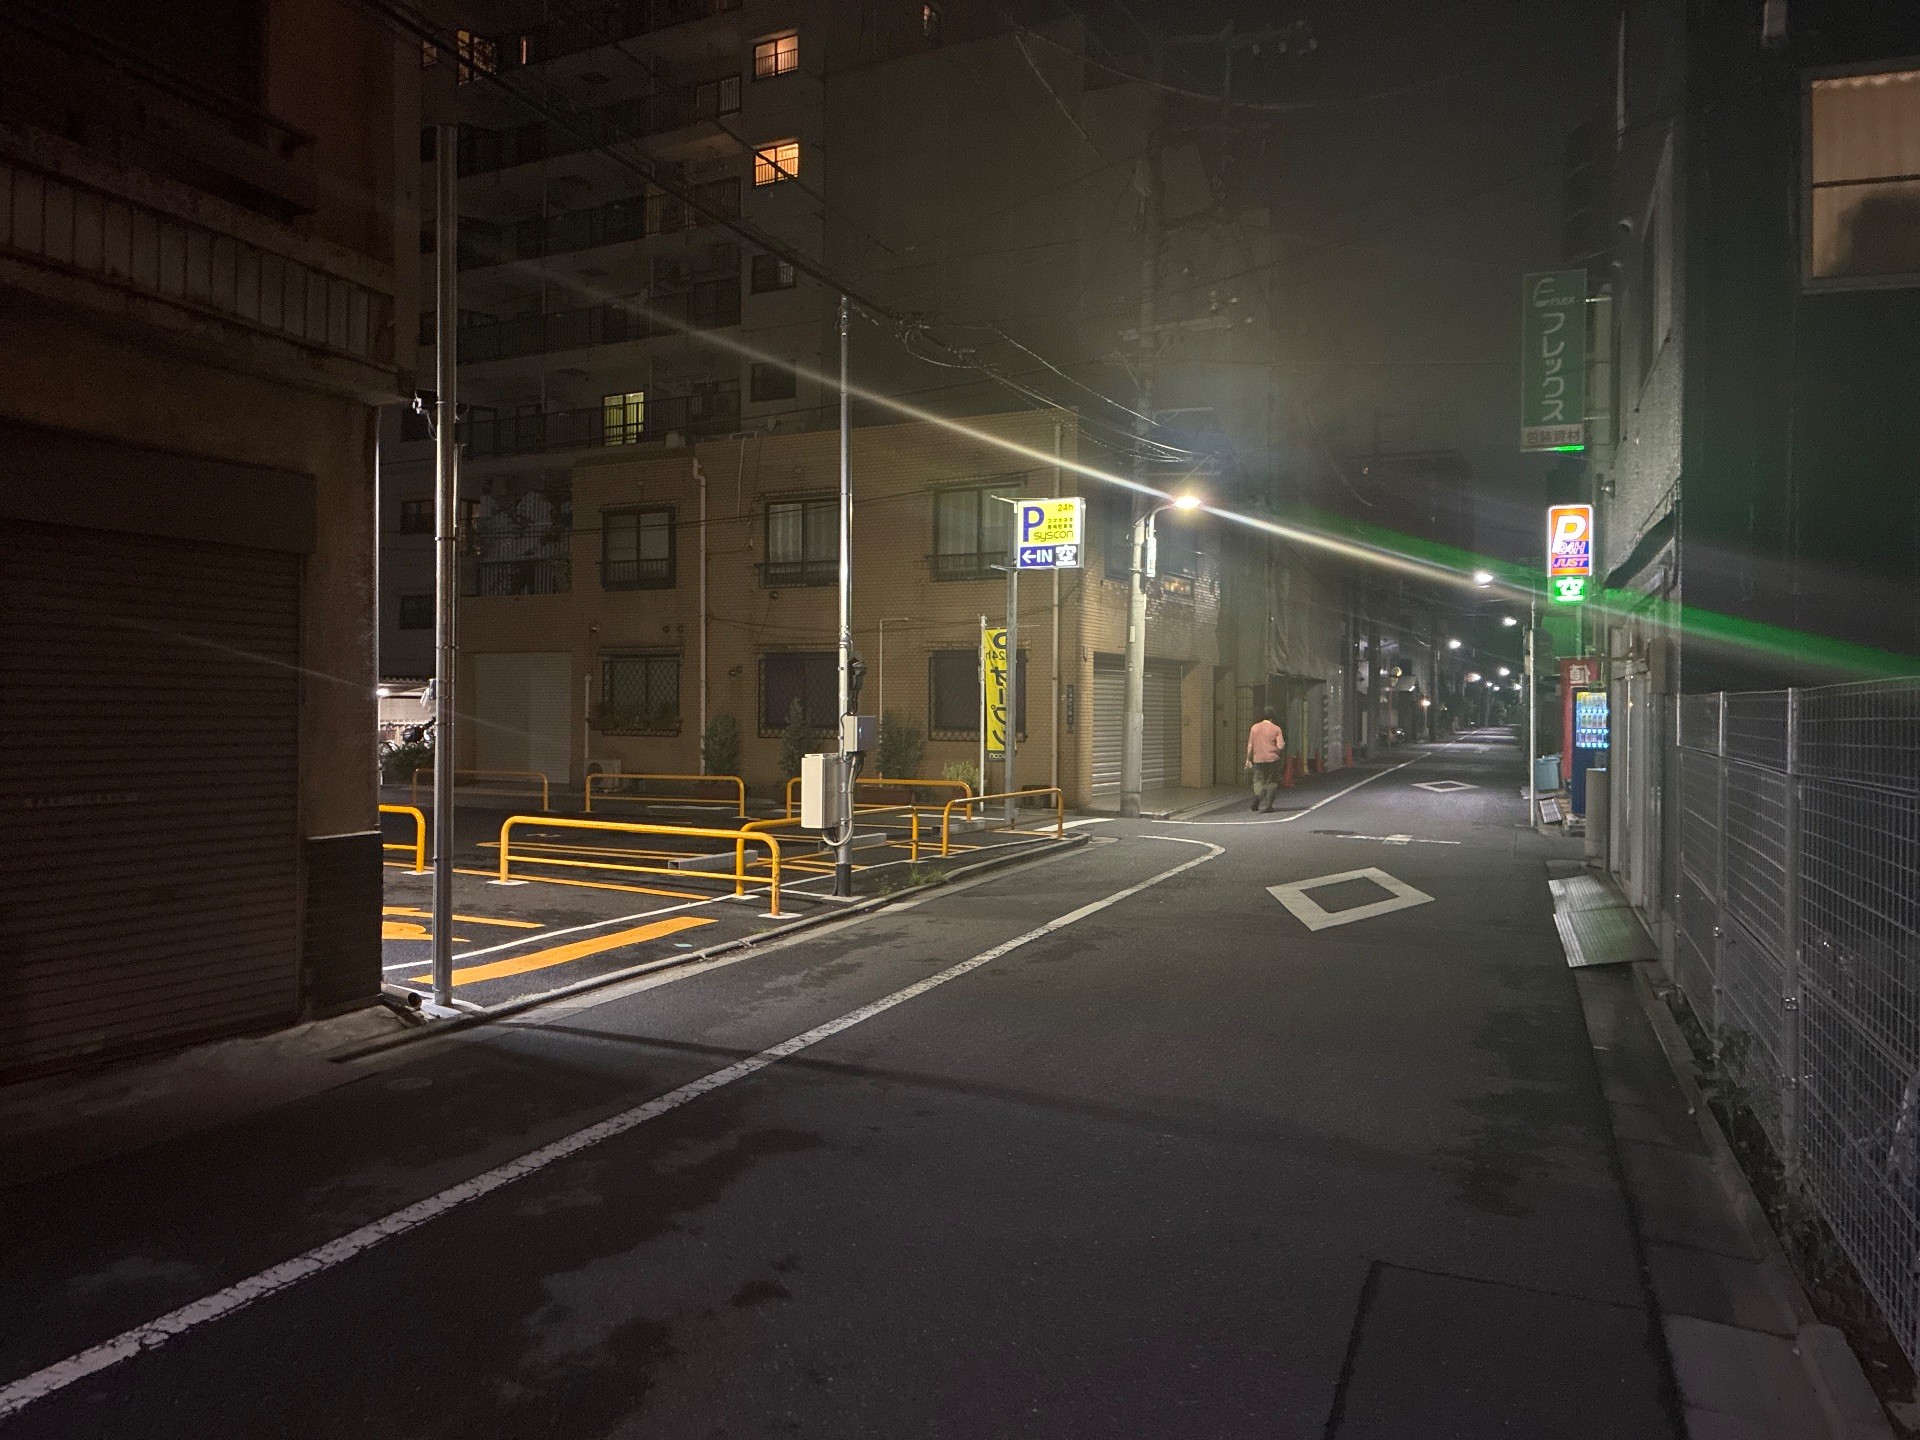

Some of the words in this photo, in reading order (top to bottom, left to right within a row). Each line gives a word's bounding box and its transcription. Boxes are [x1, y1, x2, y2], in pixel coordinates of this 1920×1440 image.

[1540, 311, 1566, 423] フレックス
[1057, 504, 1074, 512] 24h
[1023, 506, 1045, 542] P
[1033, 530, 1074, 542] syscon
[1552, 515, 1587, 554] P
[1036, 549, 1053, 563] IN
[1055, 544, 1077, 566] 空
[1556, 541, 1586, 555] 24H
[1553, 557, 1587, 567] JUST
[1555, 576, 1585, 602] 空
